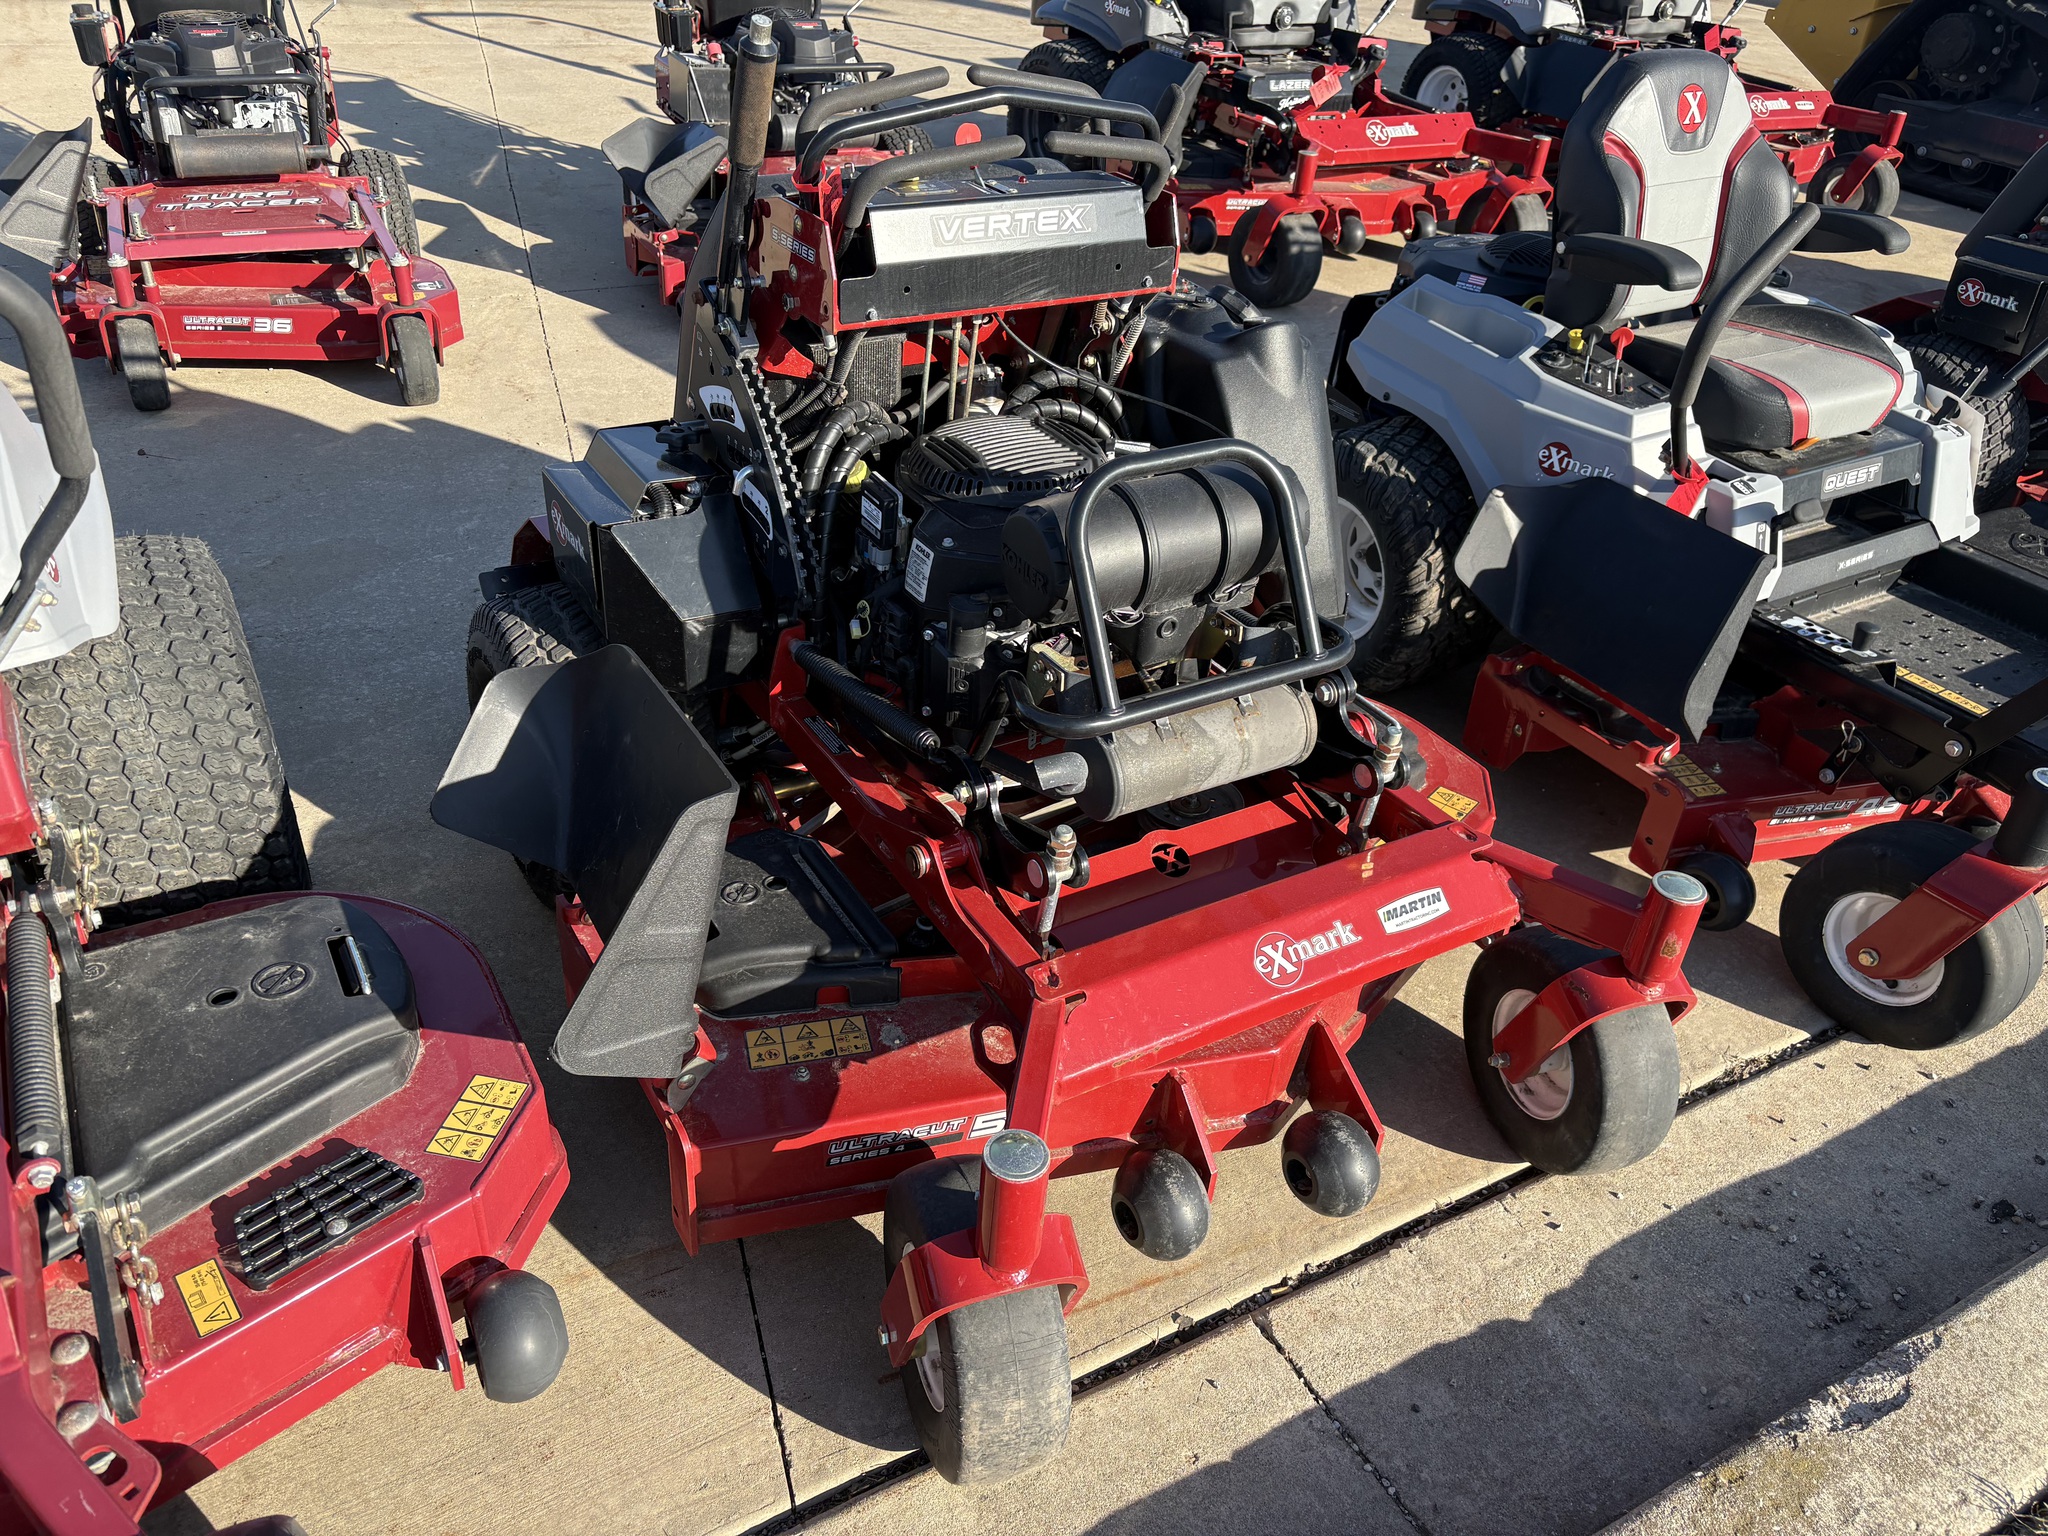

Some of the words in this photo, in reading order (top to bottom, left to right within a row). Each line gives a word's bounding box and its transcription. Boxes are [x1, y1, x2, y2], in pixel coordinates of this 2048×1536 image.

[1269, 79, 1311, 91] LAZER
[1683, 90, 1704, 125] X
[1750, 97, 1791, 113] eXmark
[1366, 121, 1419, 143] eXmark
[156, 198, 323, 211] TRACER
[183, 190, 293, 201] TURF
[936, 205, 1090, 243] VERTEX
[1957, 282, 2019, 313] eXmark
[183, 316, 251, 325] ULTRACUT
[253, 318, 292, 333] 36
[1539, 446, 1615, 480] eXmark
[1824, 463, 1881, 492] QUEST
[550, 506, 588, 563] eXmark
[1002, 542, 1049, 595] KOHLER
[1774, 800, 1858, 817] ULTRACUT
[1383, 890, 1442, 922] MARTIN
[1255, 920, 1363, 979] eXmark
[829, 1118, 967, 1154] ULTRACUT
[968, 1111, 1007, 1139] 5
[829, 1147, 890, 1165] SERIES
[894, 1144, 905, 1153] 4
